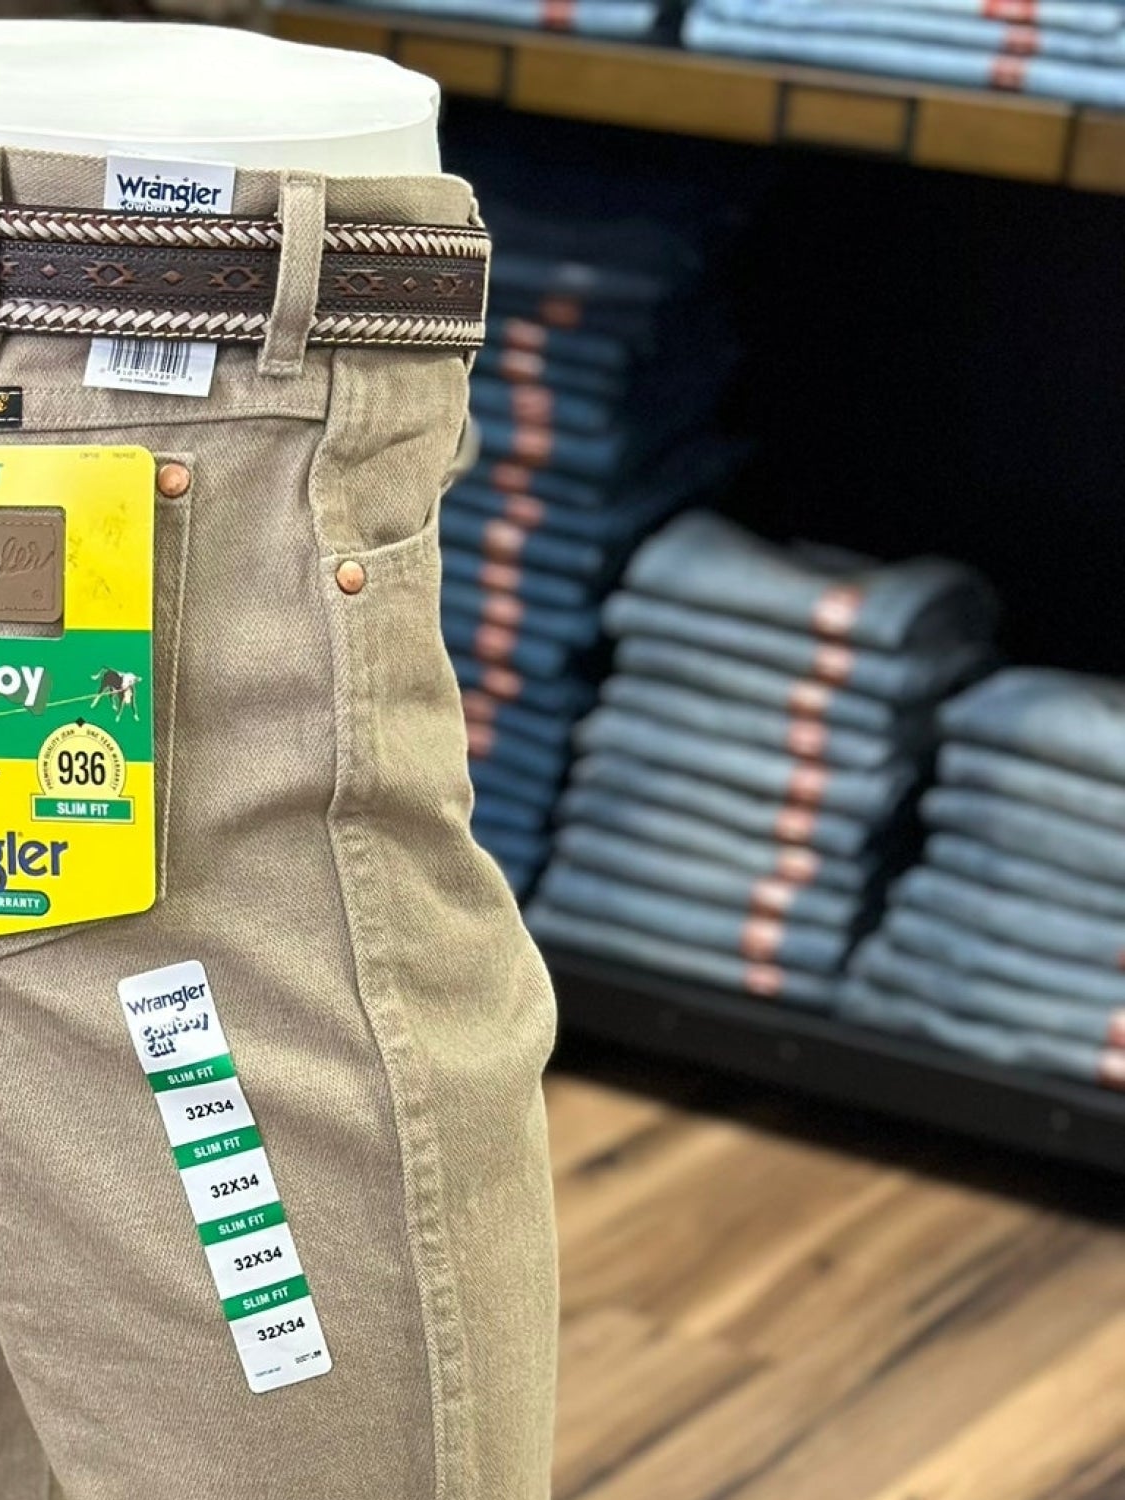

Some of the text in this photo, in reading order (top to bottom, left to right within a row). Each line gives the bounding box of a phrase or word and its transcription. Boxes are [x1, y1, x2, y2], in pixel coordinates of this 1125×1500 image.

[116, 174, 222, 212] Wrangler
[57, 750, 107, 786] 936
[56, 801, 110, 817] SLIM FIT
[126, 983, 206, 1016] Wrangler
[140, 1012, 209, 1042] Cowboy
[166, 1065, 215, 1085] SLIM FIT
[185, 1099, 235, 1121] 32X34
[192, 1136, 241, 1159] SLIM FIT
[210, 1173, 260, 1199] 32X34
[217, 1212, 265, 1236] SLIM FIT
[233, 1245, 283, 1271] 32X34
[242, 1286, 289, 1311] SLIM FIT
[257, 1316, 306, 1341] 32X34
